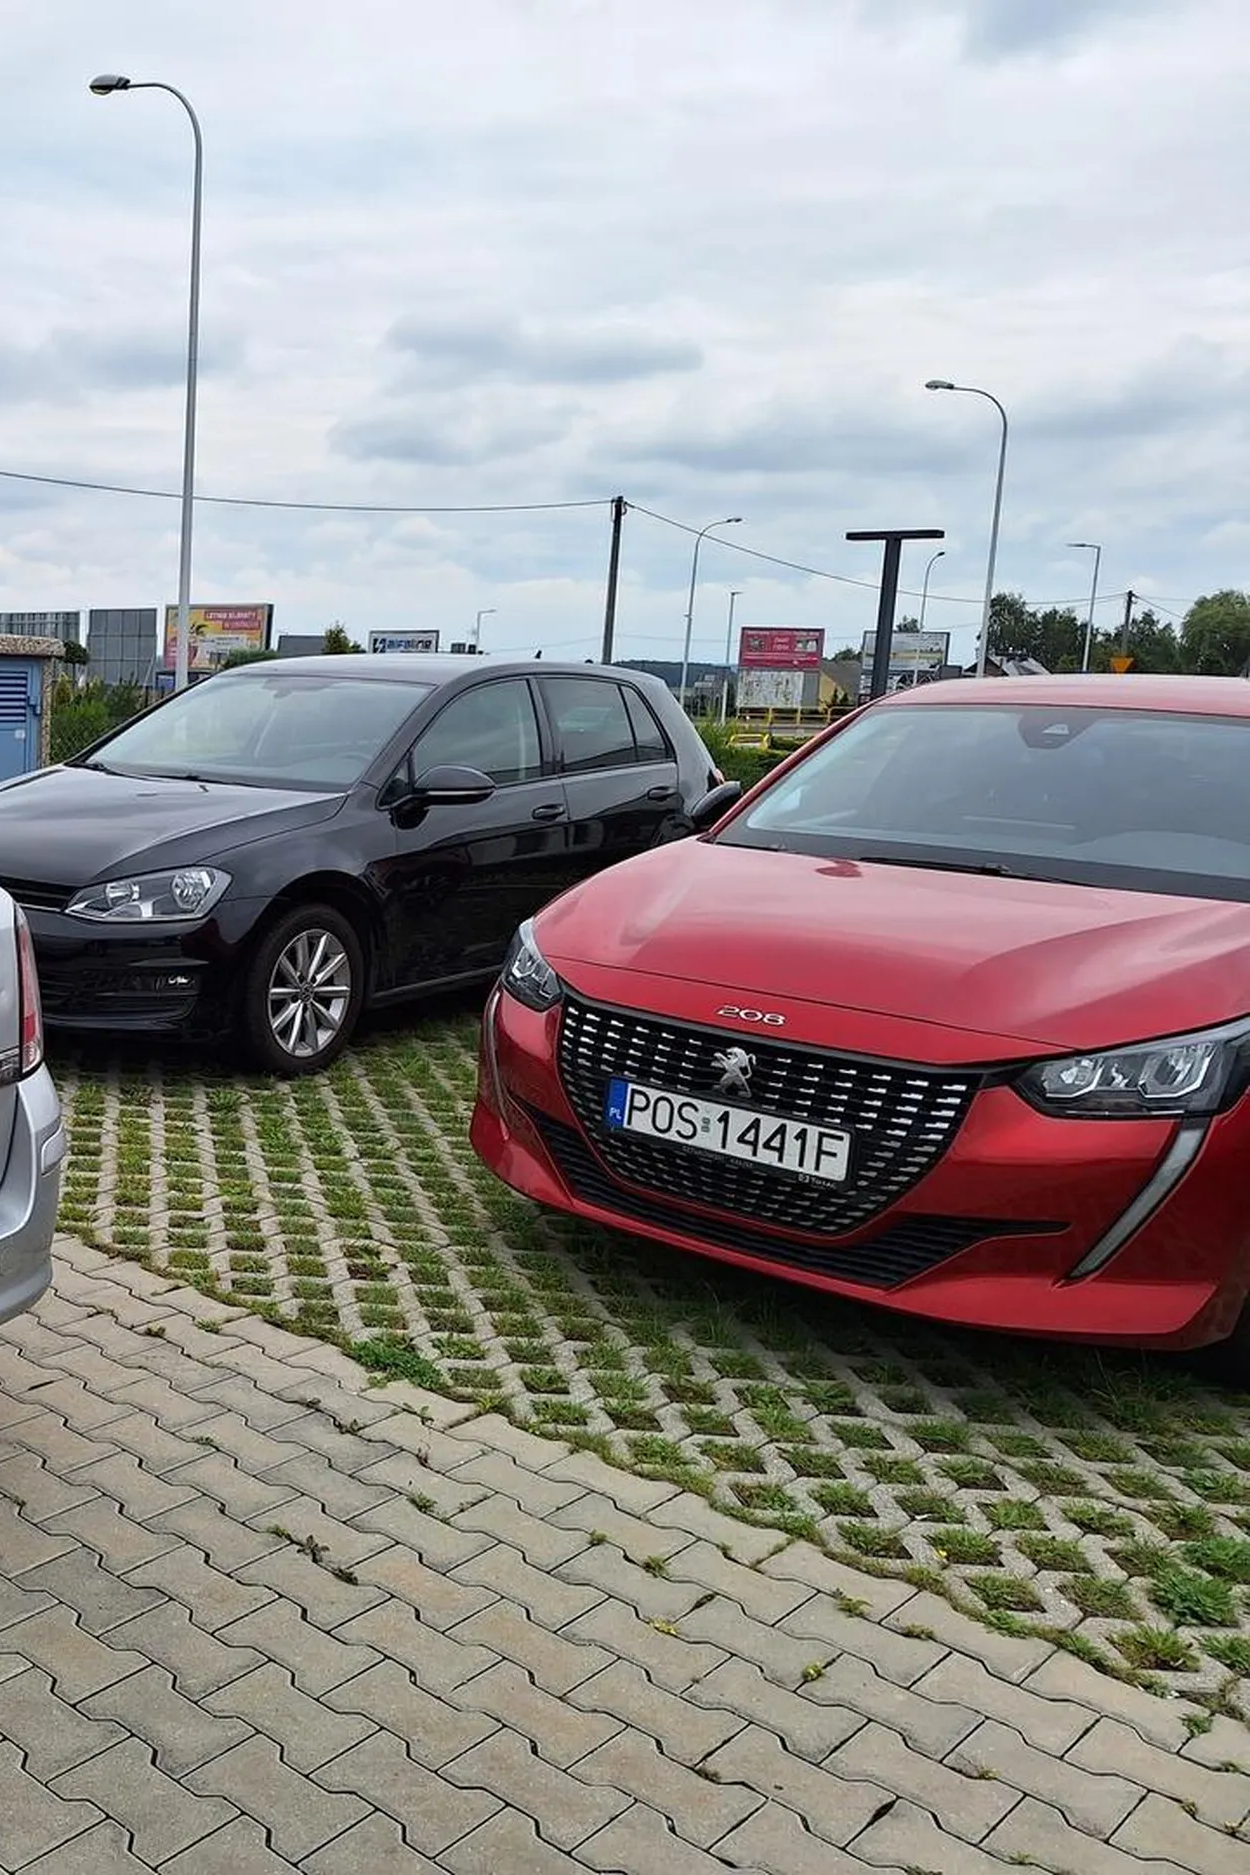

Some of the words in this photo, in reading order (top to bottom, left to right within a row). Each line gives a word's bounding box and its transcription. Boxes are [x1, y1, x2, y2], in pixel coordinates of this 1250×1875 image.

[716, 1005, 786, 1026] 208
[608, 1106, 623, 1120] PL
[626, 1087, 699, 1141] POS
[716, 1110, 845, 1173] 1441F
